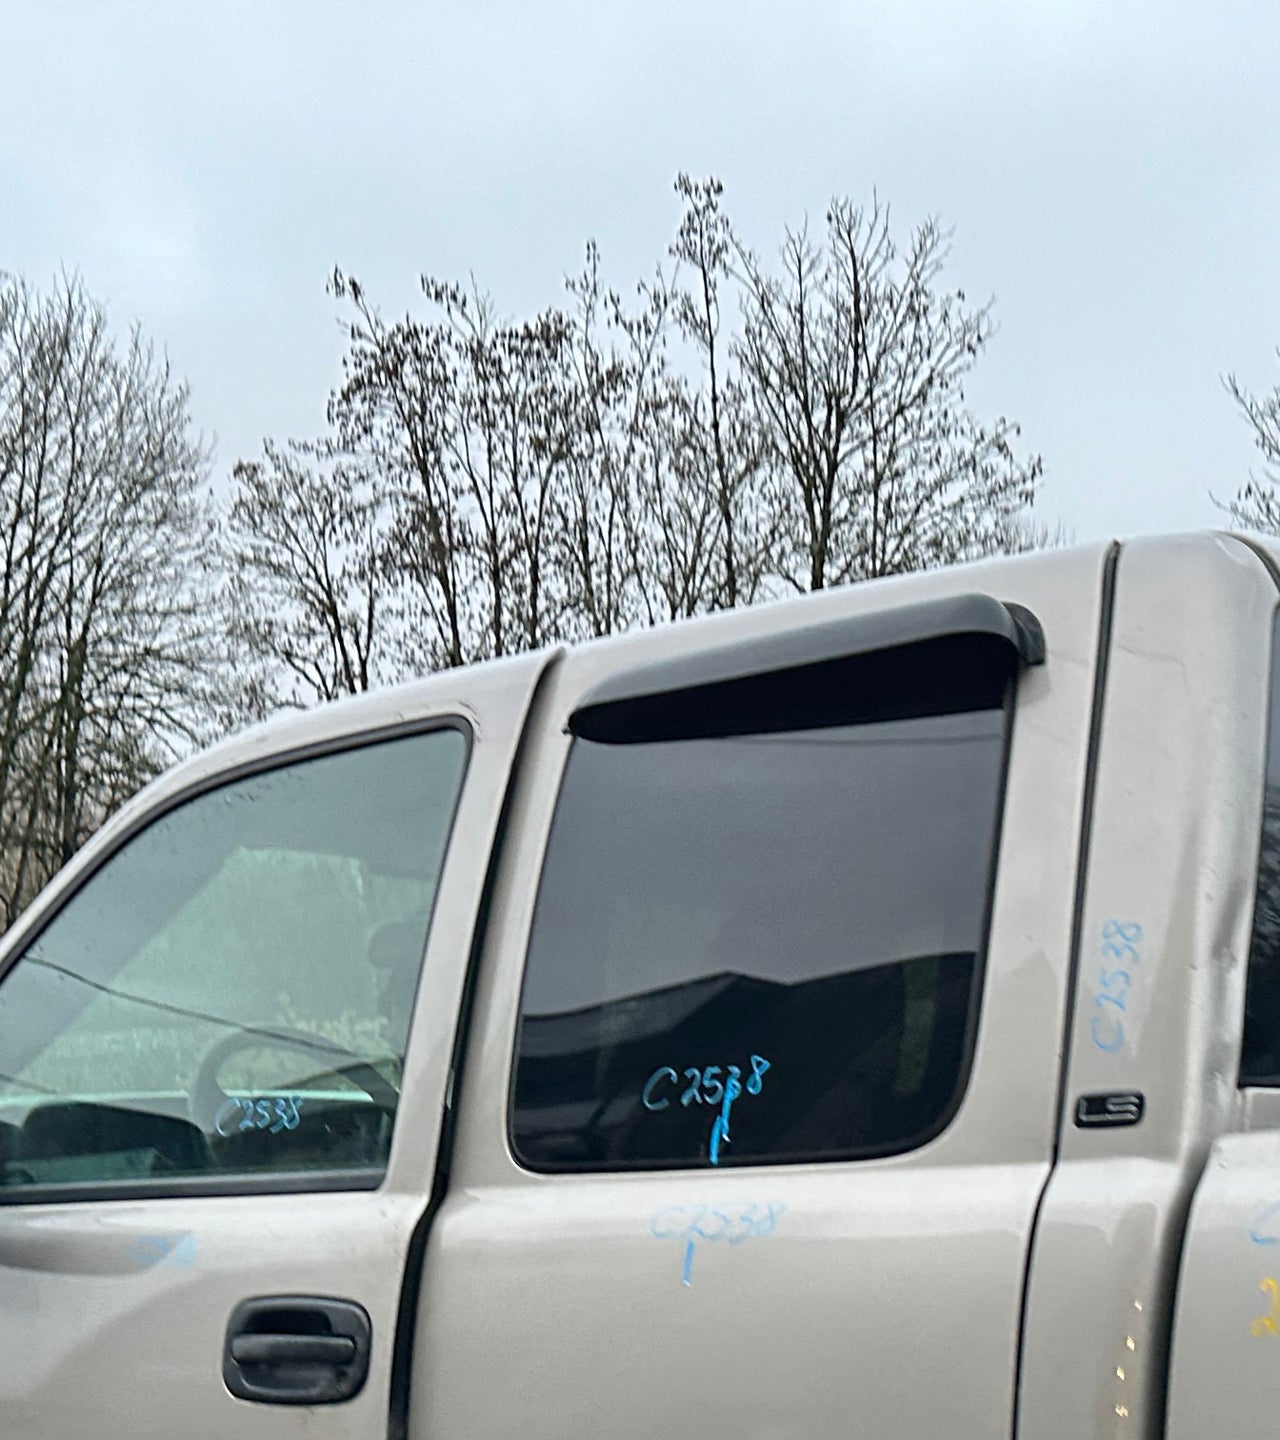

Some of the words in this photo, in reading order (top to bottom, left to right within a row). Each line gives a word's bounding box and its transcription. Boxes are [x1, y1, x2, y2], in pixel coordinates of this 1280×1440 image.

[1089, 919, 1144, 1054] C2538
[641, 1054, 771, 1111] C2538
[214, 1094, 304, 1136] C2538
[1077, 1095, 1142, 1124] LS
